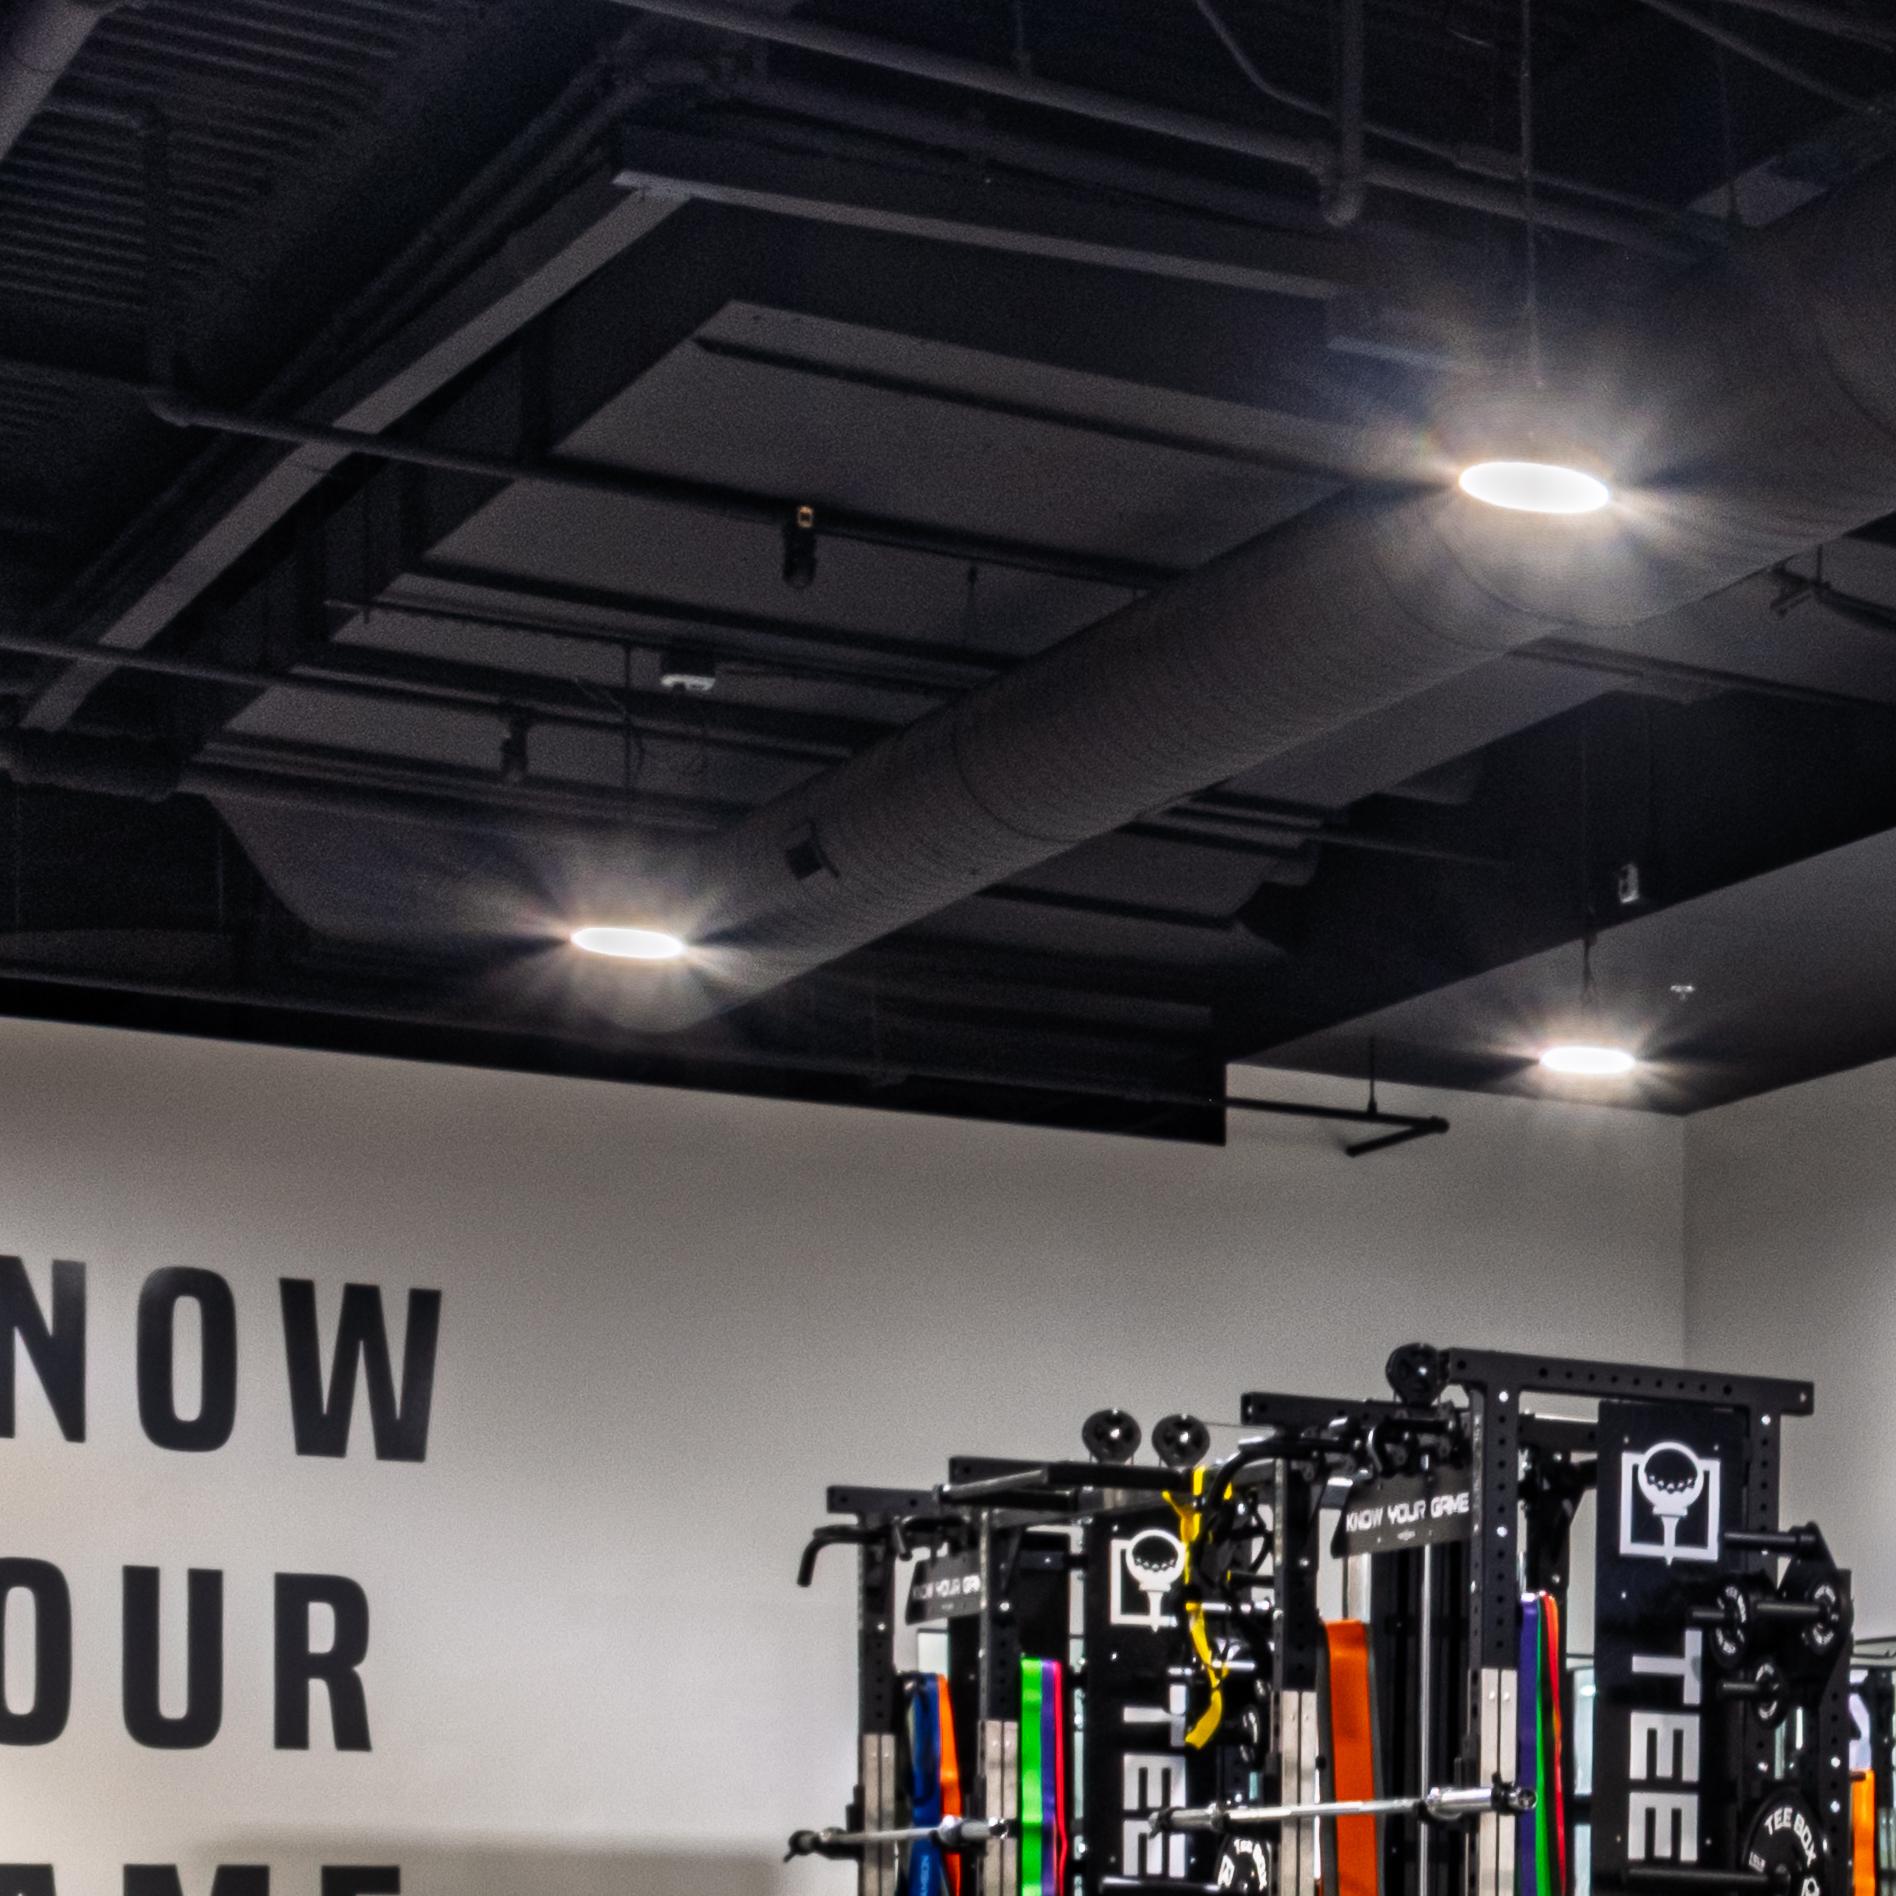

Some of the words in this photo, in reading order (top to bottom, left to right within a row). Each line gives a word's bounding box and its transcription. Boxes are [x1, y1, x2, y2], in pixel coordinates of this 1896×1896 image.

[1346, 1506, 1384, 1532] KNOW
[1387, 1500, 1426, 1525] YOUR
[1431, 1492, 1470, 1518] GAME
[0, 1557, 372, 1752] OUR
[1628, 1628, 1703, 1864] TEE
[1122, 1683, 1187, 1878] TEE
[1764, 1806, 1793, 1836] TEE
[1793, 1813, 1817, 1868] BOX
